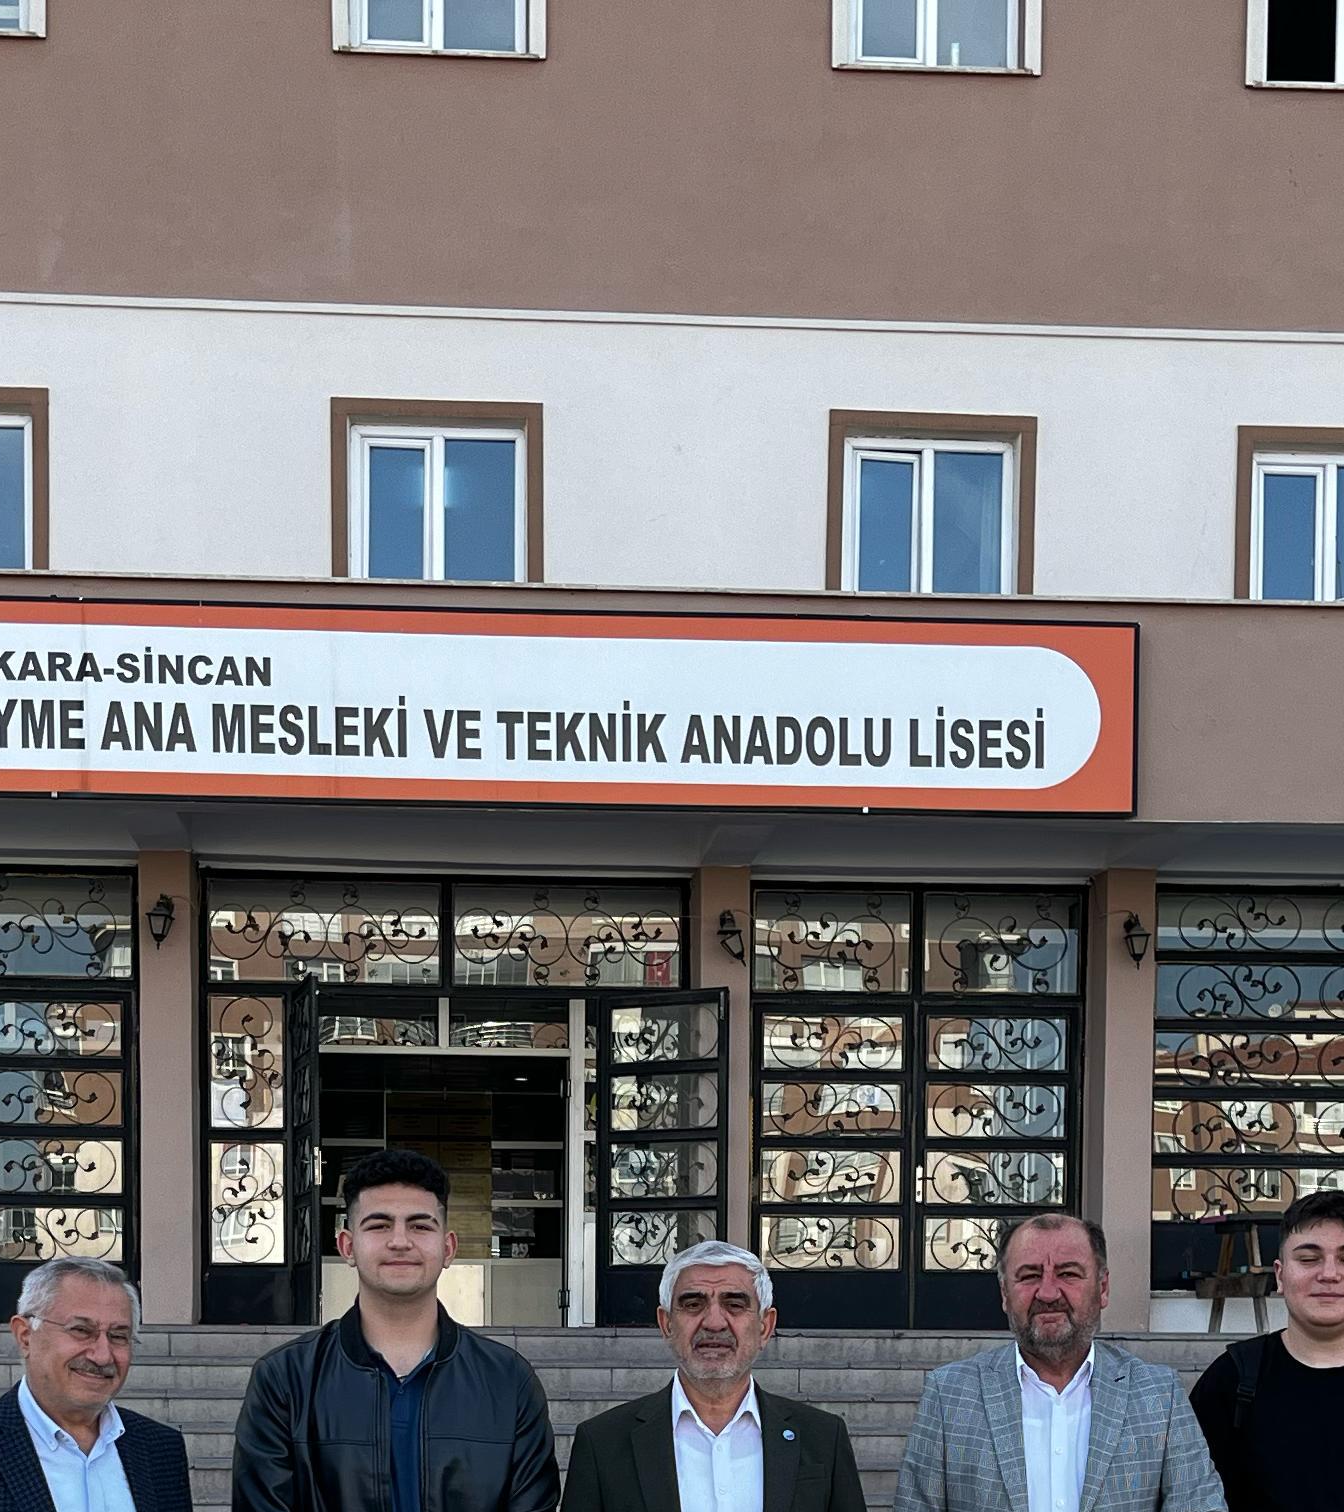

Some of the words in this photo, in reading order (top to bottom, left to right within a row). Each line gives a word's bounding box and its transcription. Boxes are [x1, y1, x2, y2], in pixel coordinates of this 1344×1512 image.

[100, 700, 198, 752] ANA
[211, 695, 408, 758] MESLEKİ
[423, 708, 482, 760] VE
[496, 700, 668, 763] TEKNİK
[680, 713, 892, 768] ANADOLU
[909, 706, 1046, 770] LİSESİ
